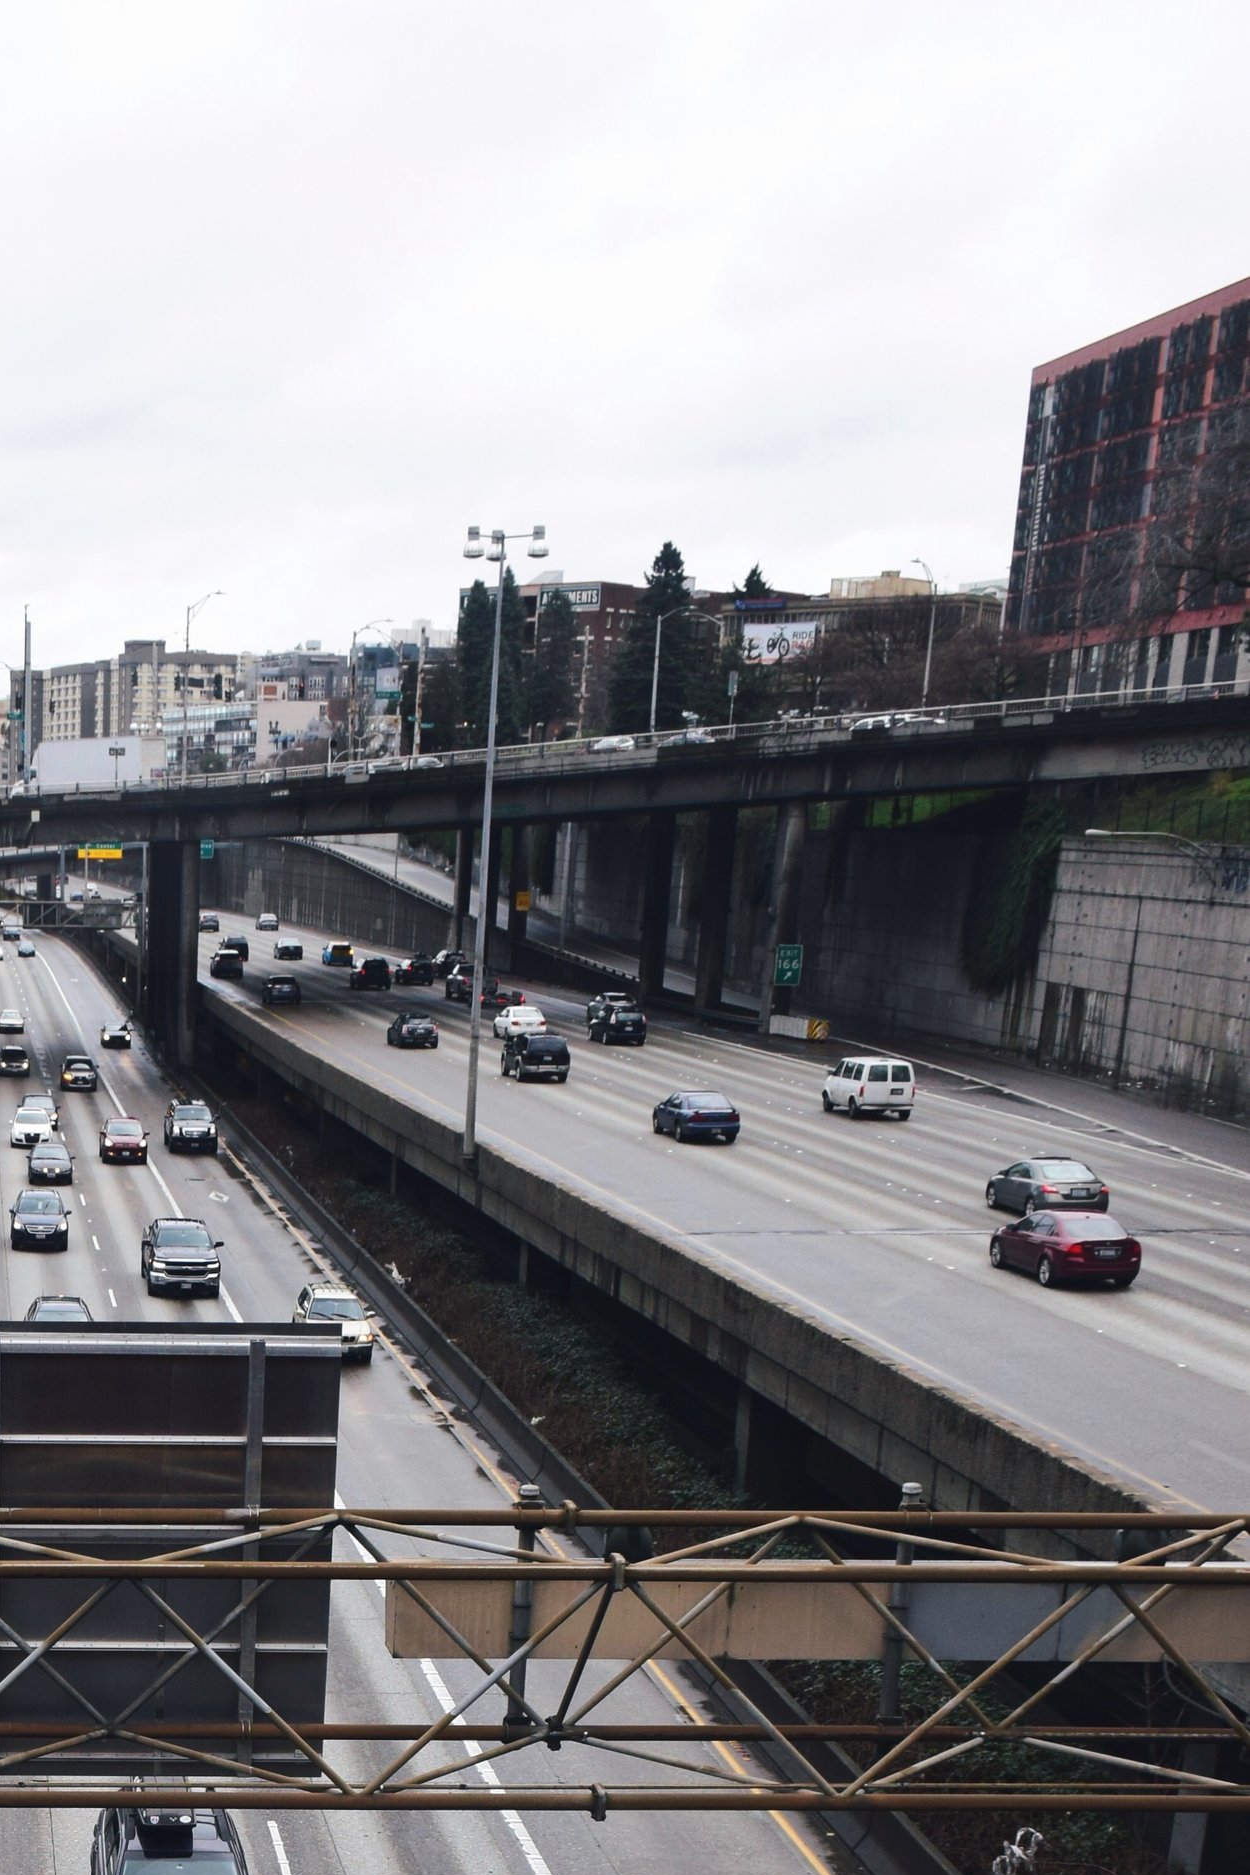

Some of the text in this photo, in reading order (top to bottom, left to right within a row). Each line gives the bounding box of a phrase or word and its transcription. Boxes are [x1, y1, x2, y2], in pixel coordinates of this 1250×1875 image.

[541, 590, 598, 605] AMENTS
[792, 631, 814, 640] RIDE
[778, 959, 799, 969] 166
